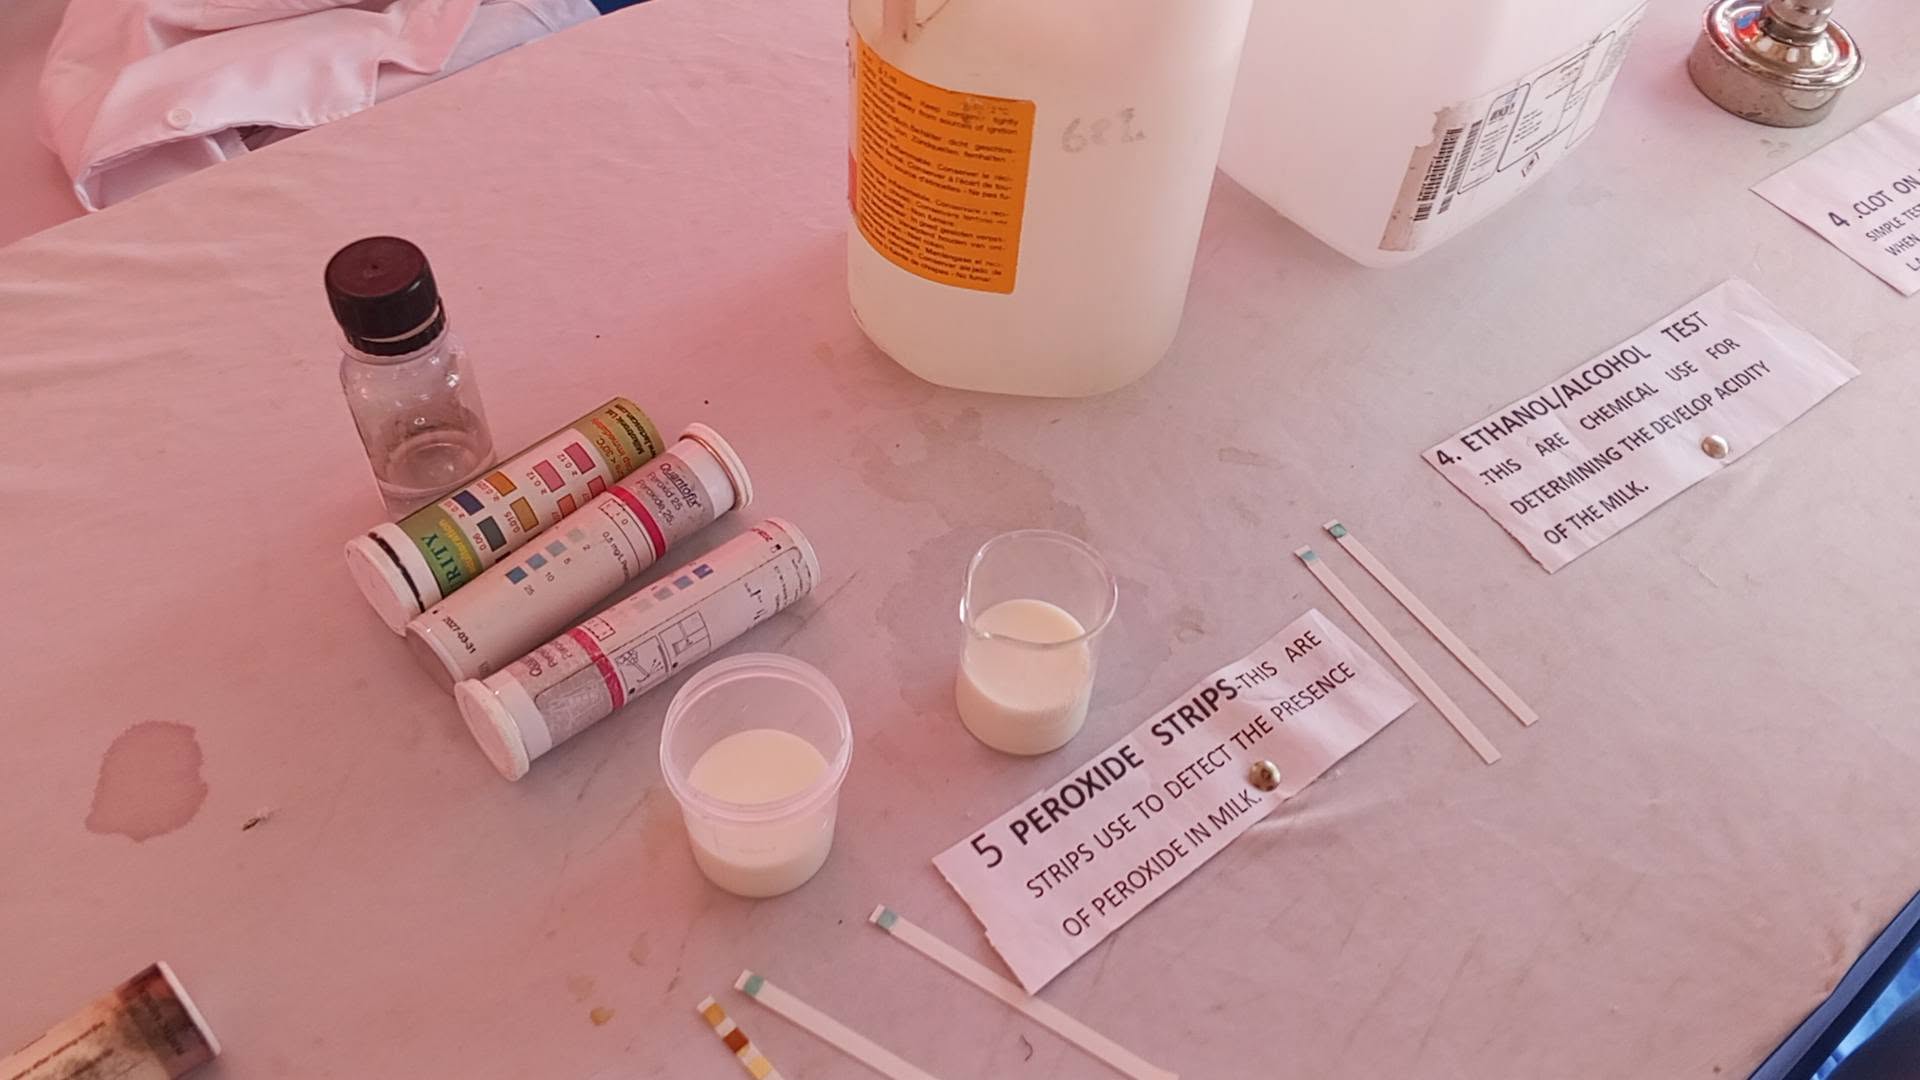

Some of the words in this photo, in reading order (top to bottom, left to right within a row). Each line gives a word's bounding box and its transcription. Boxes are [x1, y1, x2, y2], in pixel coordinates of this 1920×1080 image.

[1828, 211, 1850, 227] 4
[1865, 216, 1906, 242] SIMPLE
[1435, 449, 1463, 466] 4.
[1460, 345, 1652, 453] ETHANOL/ALCOHOL
[1660, 311, 1709, 343] TEST
[1510, 446, 1623, 516] DETERMINING
[1617, 427, 1655, 452] THE
[1650, 392, 1715, 436] DEVELOP
[1714, 360, 1771, 401] ACIDITY
[1534, 431, 1570, 457] ARE
[1579, 382, 1659, 431] CHEMICAL
[1665, 360, 1699, 382] USE
[1705, 337, 1741, 360] FOR
[1543, 524, 1569, 545] OF
[1565, 504, 1604, 531] THE
[1600, 480, 1650, 514] MILK.
[970, 832, 1004, 869] 5
[1008, 744, 1145, 846] PEROXIDE
[1284, 630, 1322, 664] ARE
[1026, 843, 1096, 900] STRIPS
[1093, 813, 1137, 849] USE
[1132, 794, 1165, 820] TO
[1164, 743, 1233, 800] DETECT
[1229, 714, 1275, 751] THE
[1270, 661, 1357, 723] PRESENCE
[1062, 907, 1092, 937] OF
[1091, 838, 1190, 917] PEROXIDE
[1184, 822, 1213, 847] IN
[1207, 788, 1263, 831] MILK.
